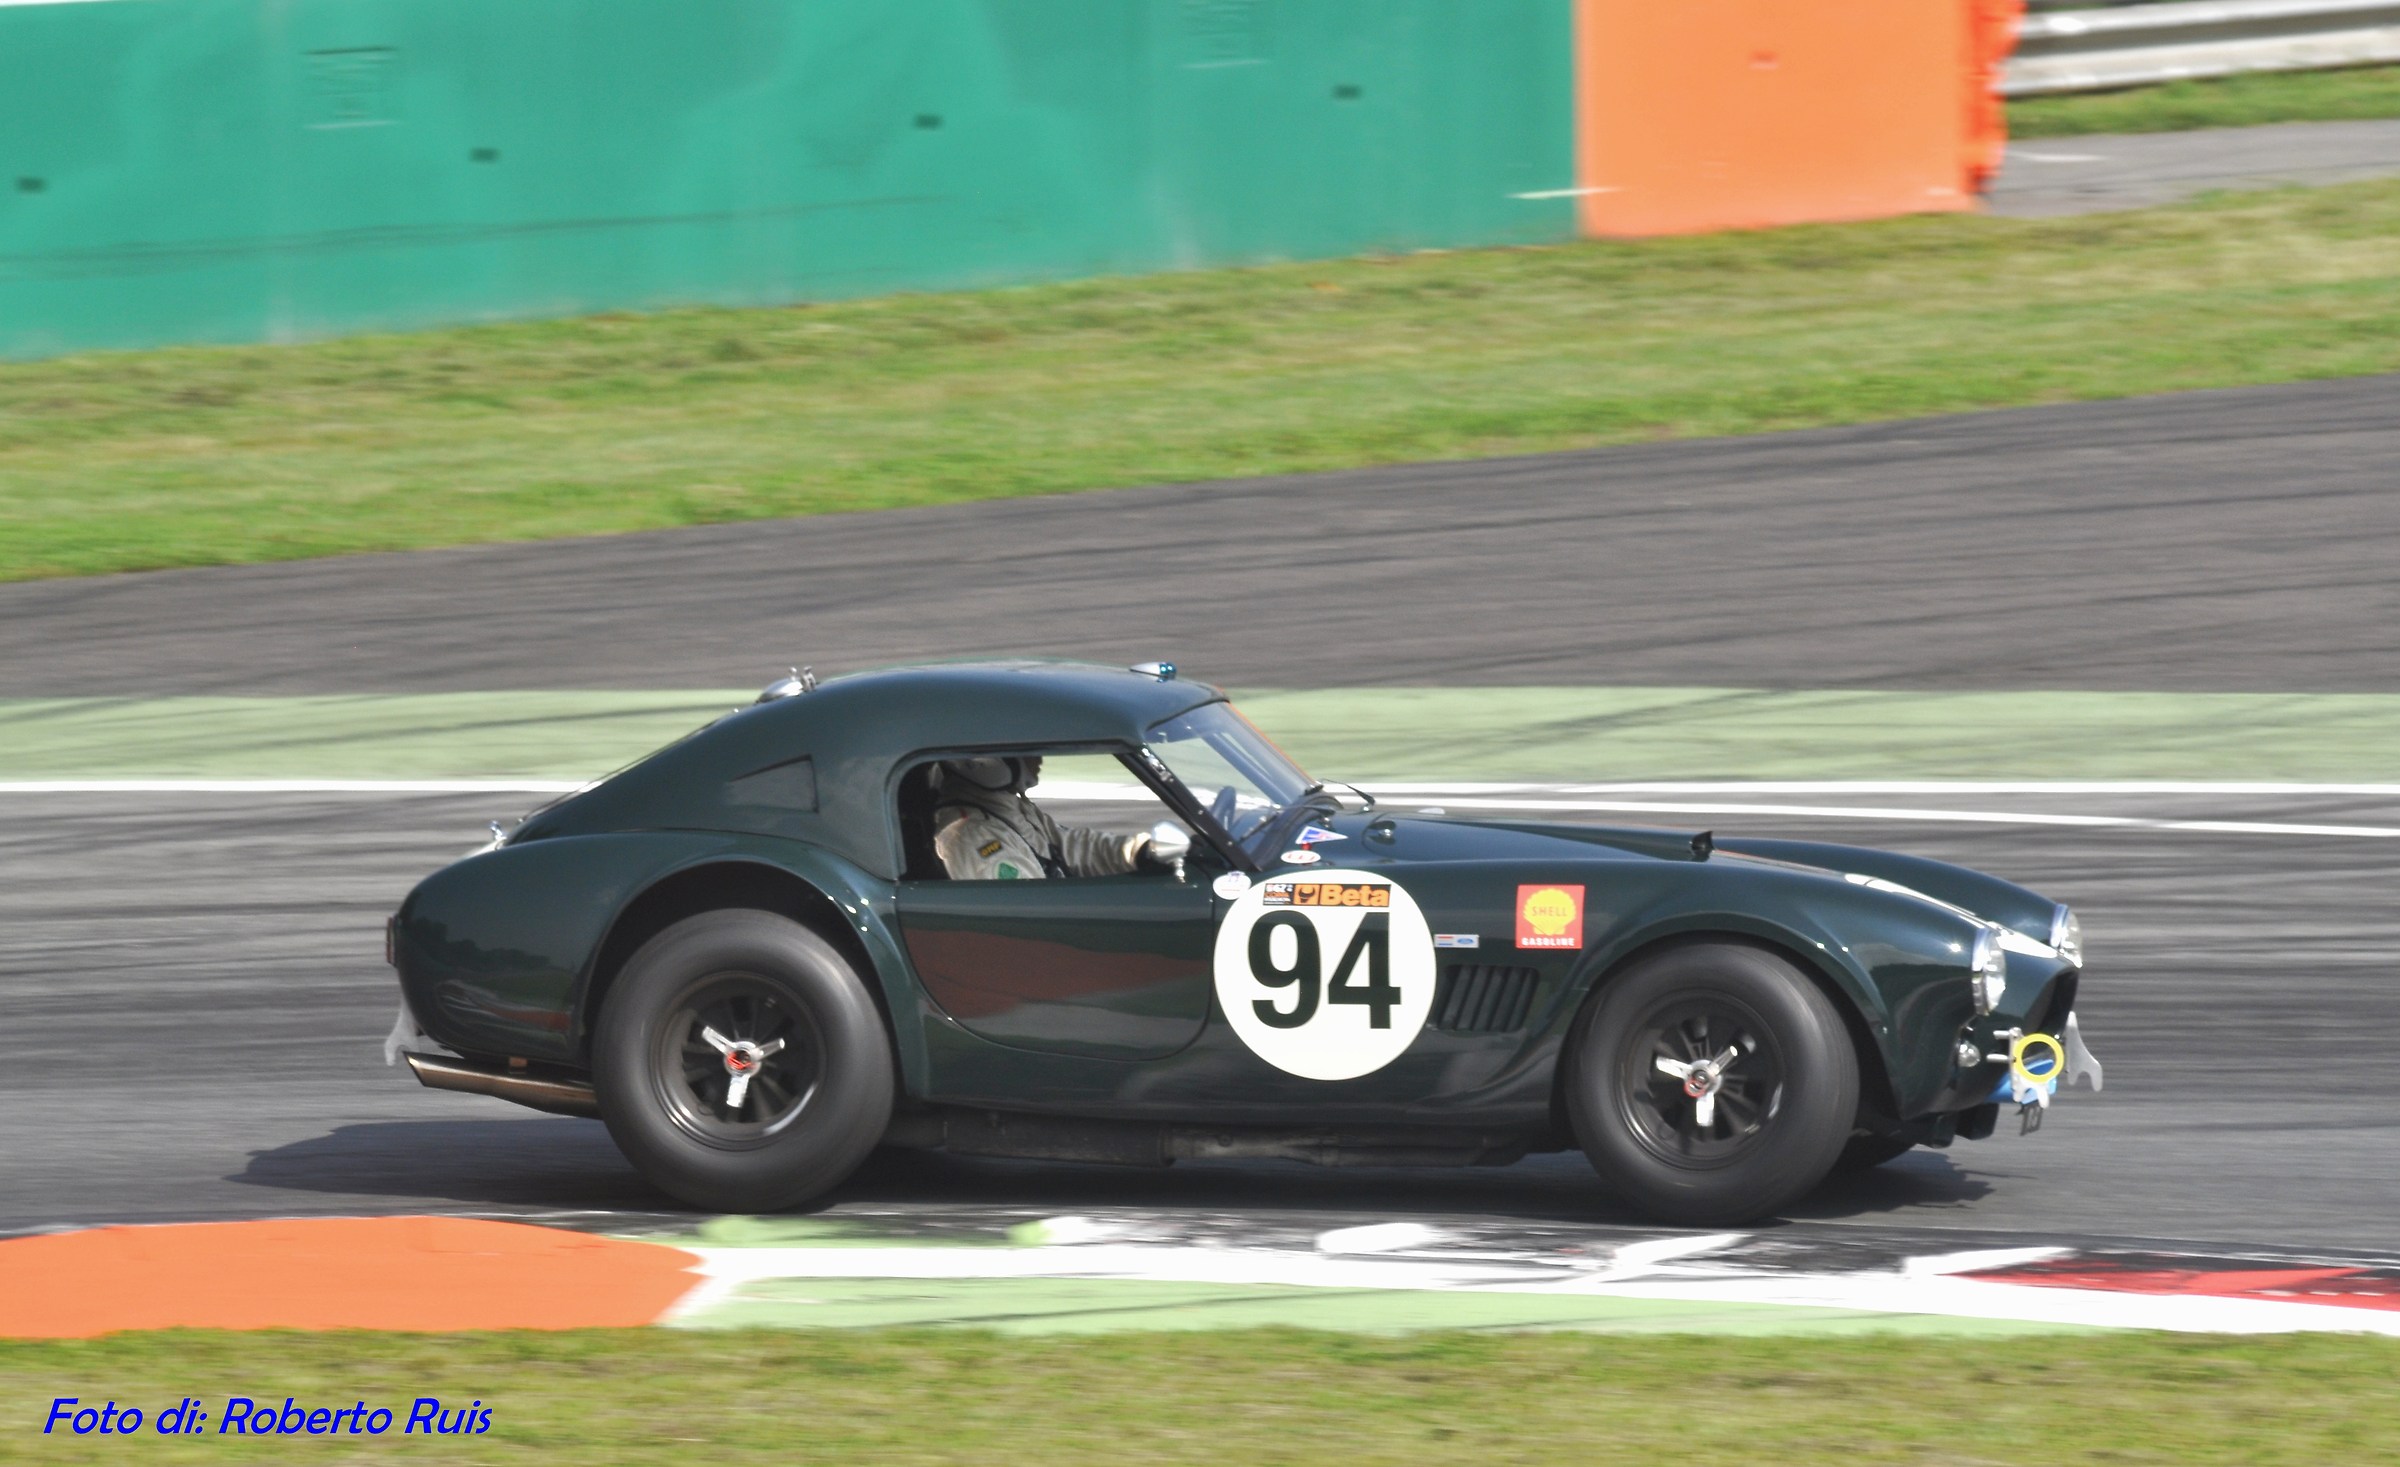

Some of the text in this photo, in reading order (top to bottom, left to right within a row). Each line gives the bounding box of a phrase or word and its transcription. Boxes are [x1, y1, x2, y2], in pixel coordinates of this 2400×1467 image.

[1320, 885, 1389, 906] Beta
[1532, 906, 1568, 917] SHELL
[1521, 937, 1575, 947] GASOLINE
[1247, 909, 1402, 1030] 94
